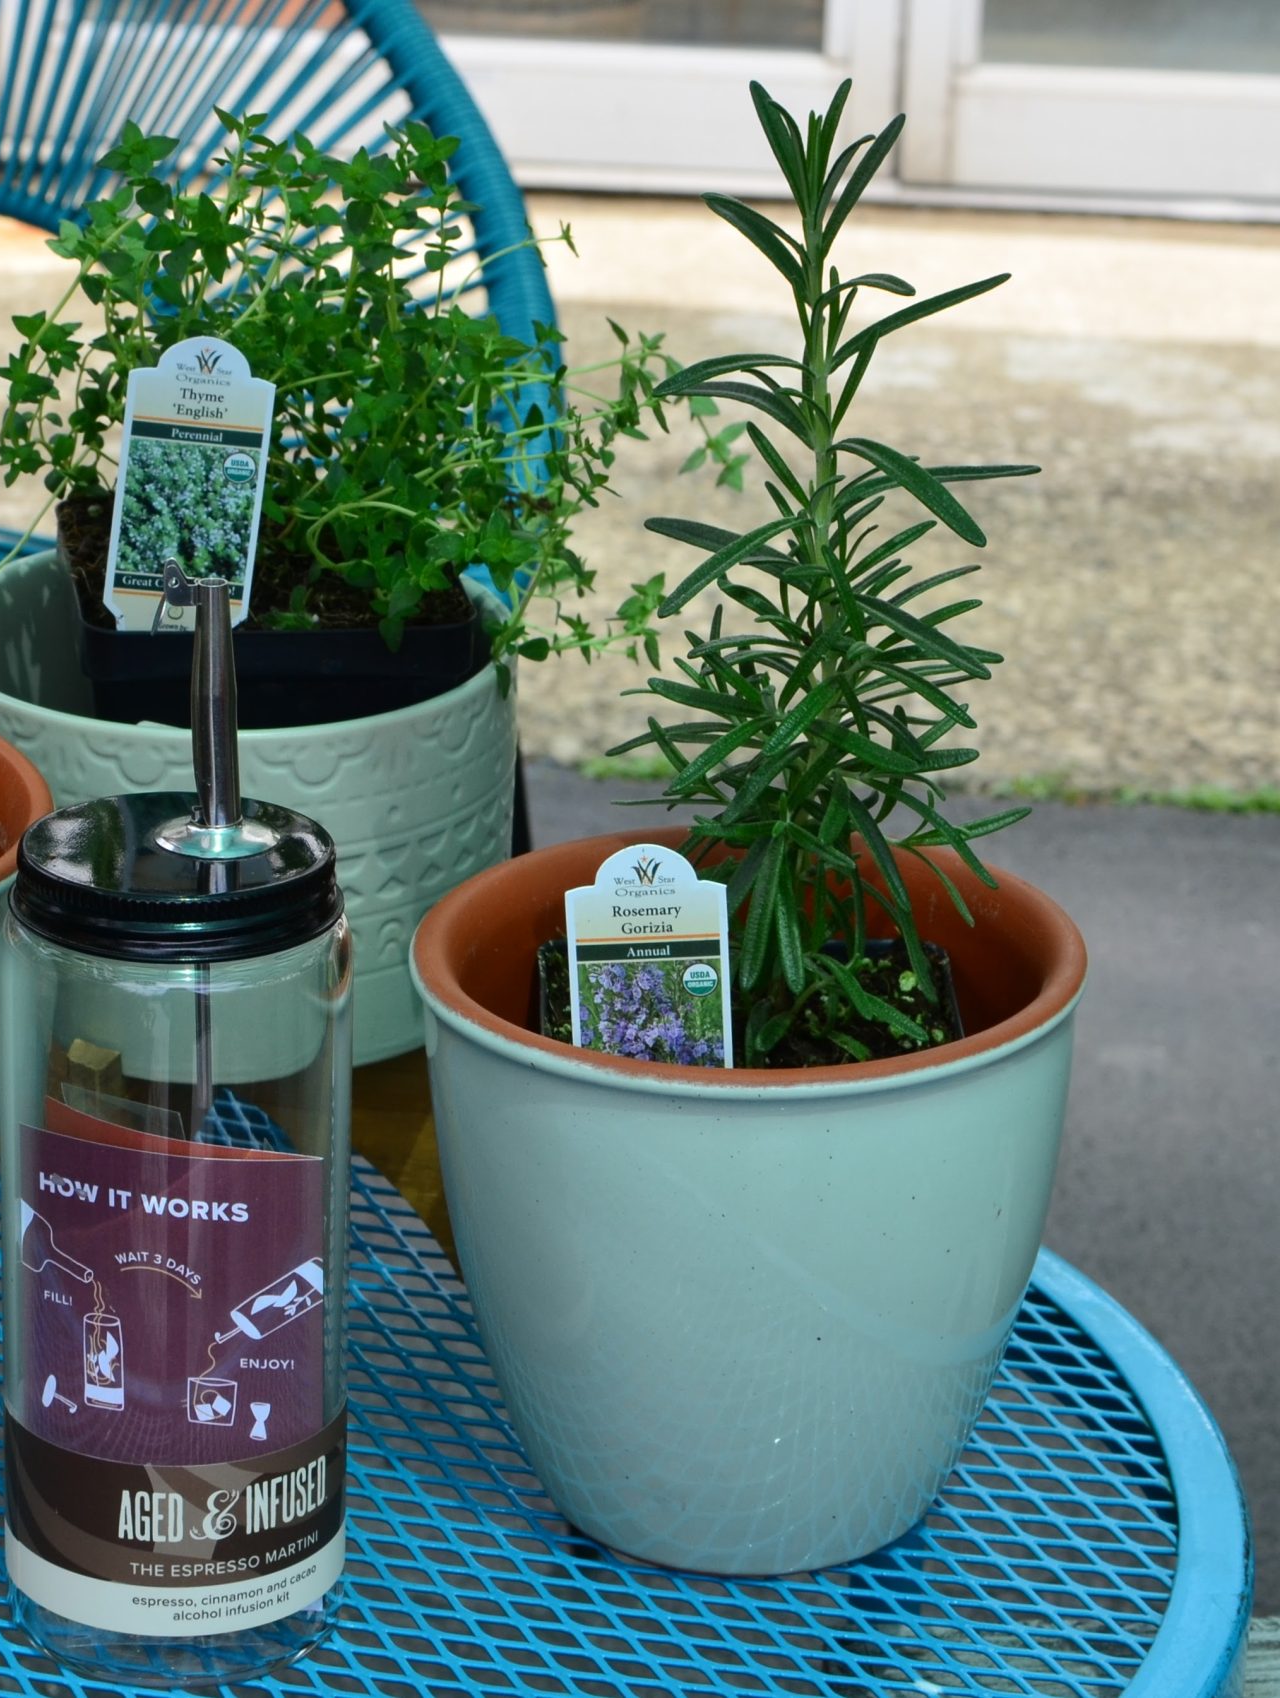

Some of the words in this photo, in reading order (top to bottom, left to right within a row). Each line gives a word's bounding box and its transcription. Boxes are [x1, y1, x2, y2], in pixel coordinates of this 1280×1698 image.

[175, 373, 231, 386] Organics
[179, 387, 224, 403] Thyme
[171, 427, 223, 443] Perennial
[231, 459, 249, 467] USDA
[122, 575, 152, 588] Great
[613, 877, 635, 886] West
[658, 875, 675, 884] Star
[615, 888, 676, 898] Organics
[612, 905, 682, 919] Rosemary
[621, 922, 673, 935] Gorizia
[627, 945, 671, 958] Annual
[689, 971, 711, 979] USDA
[686, 980, 714, 988] ORGANIC
[39, 1171, 98, 1204] HOW
[108, 1188, 132, 1210] IT
[141, 1194, 249, 1223] WORKS
[114, 1252, 149, 1265] WAIT
[153, 1254, 162, 1265] 3
[165, 1257, 202, 1286] DAYS
[43, 1290, 73, 1307] FILL!
[239, 1358, 295, 1371] ENJOY!
[118, 1489, 184, 1543] AGED
[189, 1488, 240, 1541] &
[246, 1455, 326, 1536] INFUSED
[130, 1562, 164, 1577] THE
[170, 1555, 261, 1578] ESPRESSO
[265, 1530, 319, 1565] MARTINI
[132, 1594, 197, 1609] espresso,
[201, 1586, 264, 1606] cinnamon
[266, 1577, 287, 1594] and
[289, 1564, 317, 1585] cacao
[173, 1608, 222, 1622] alcohol
[225, 1600, 274, 1617] infusion
[276, 1591, 290, 1605] kit
